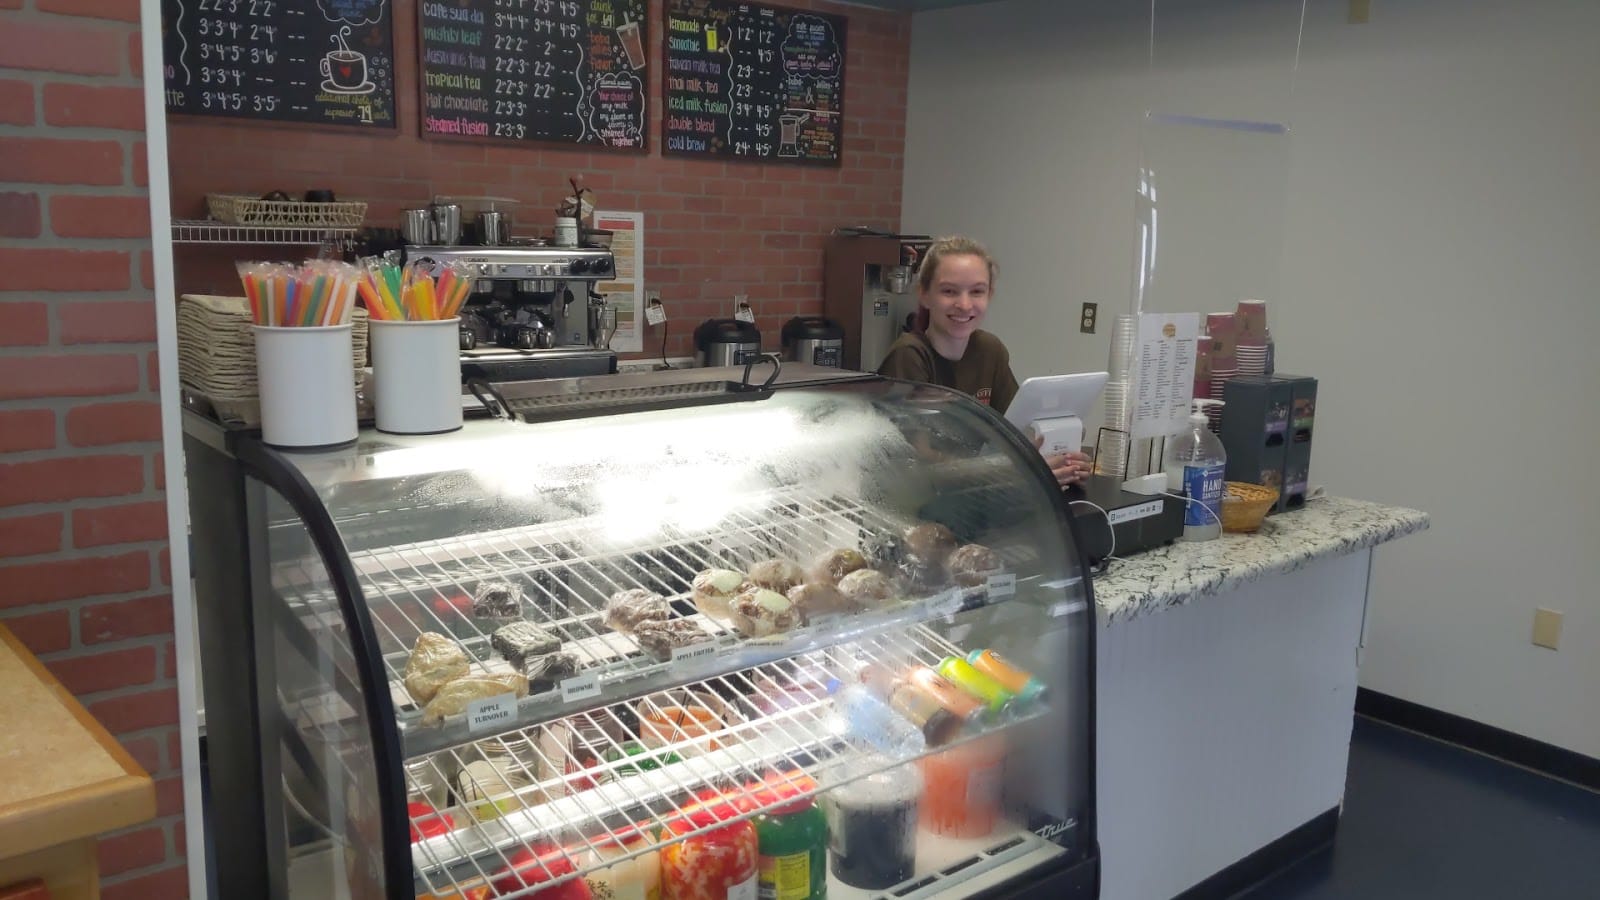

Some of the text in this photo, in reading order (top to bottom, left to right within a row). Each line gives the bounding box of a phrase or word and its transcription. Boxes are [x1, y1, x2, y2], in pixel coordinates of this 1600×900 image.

[464, 74, 481, 90] tea
[686, 97, 704, 112] milk
[704, 98, 728, 115] fusion
[460, 117, 489, 136] fusion
[668, 136, 684, 150] cold
[1202, 478, 1222, 492] HAND
[480, 704, 500, 713] APPLE
[474, 710, 508, 724] TURNOVER
